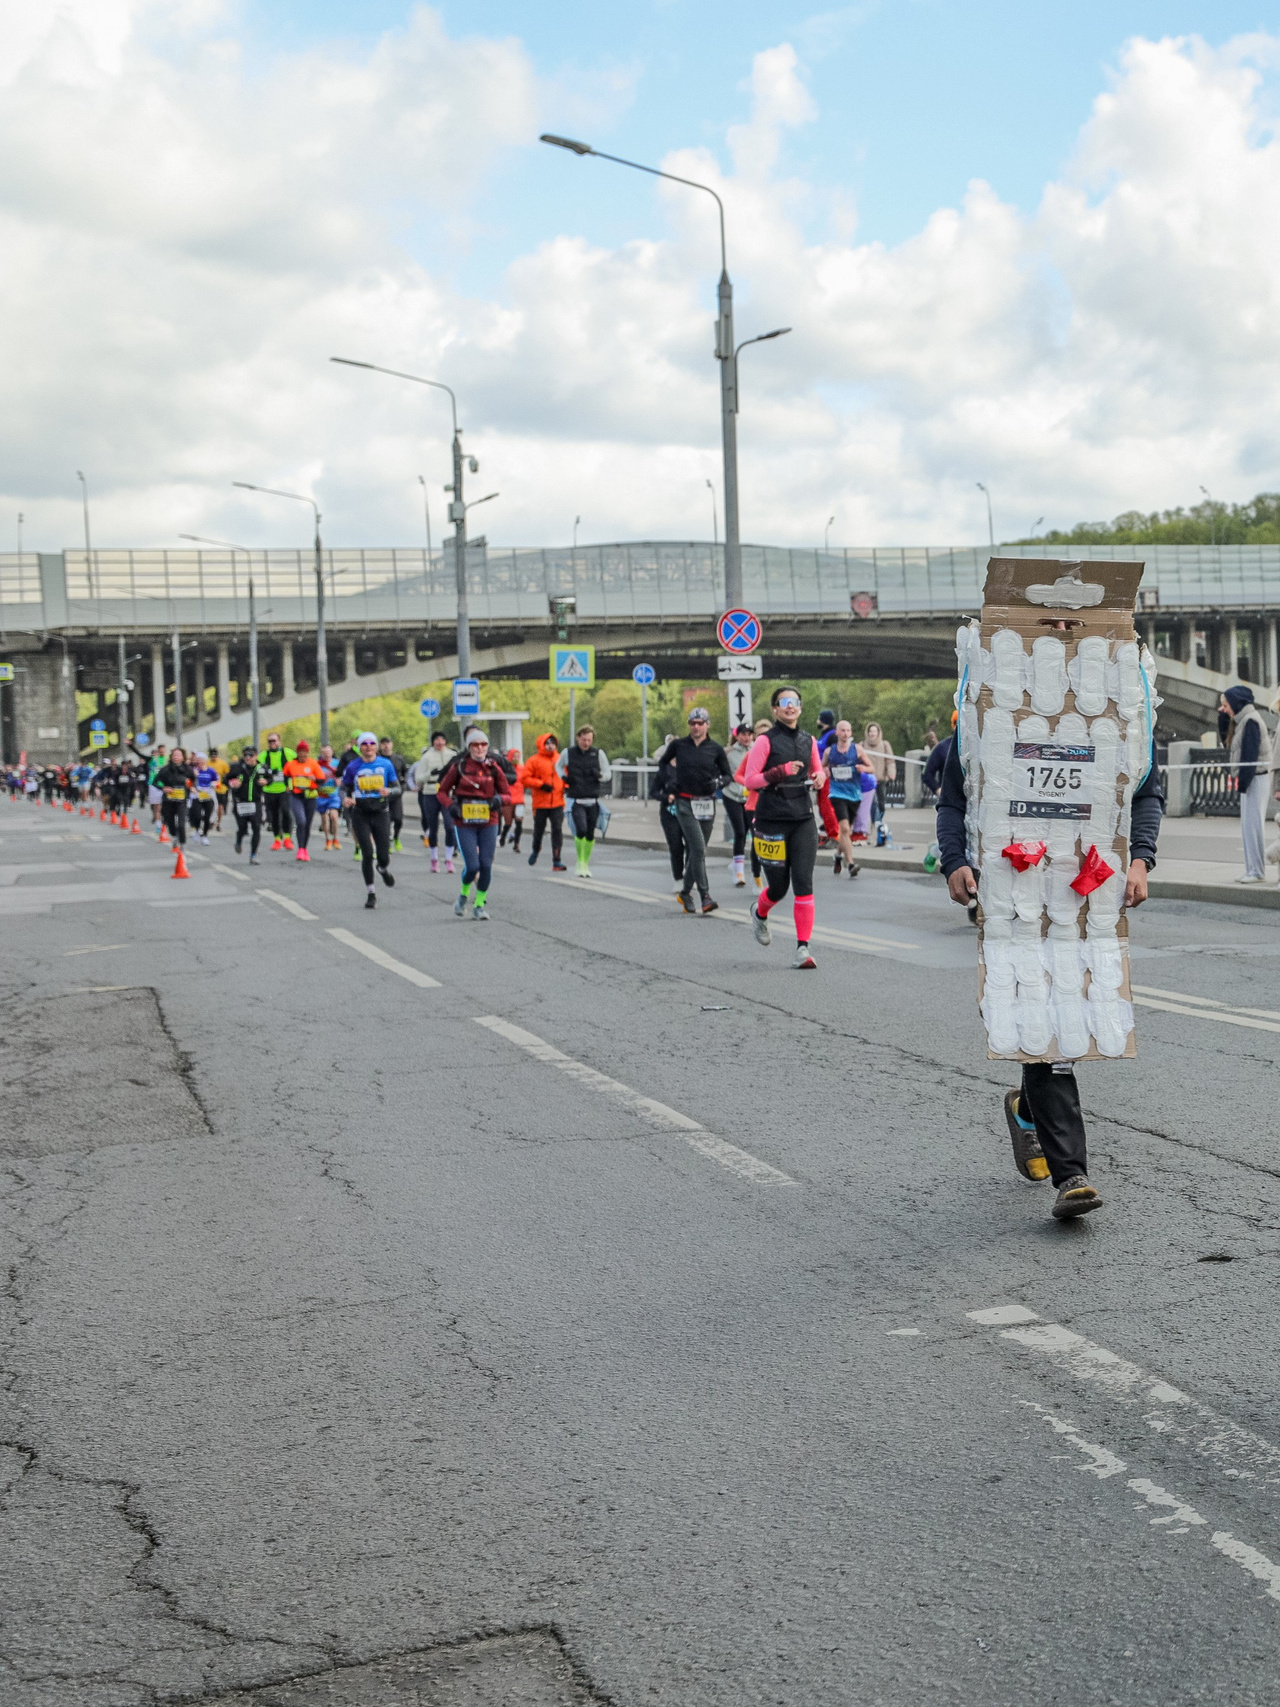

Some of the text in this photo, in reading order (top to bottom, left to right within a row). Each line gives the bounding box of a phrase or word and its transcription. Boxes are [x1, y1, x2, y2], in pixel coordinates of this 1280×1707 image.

[1026, 766, 1082, 790] 1765
[1017, 802, 1027, 814] D
[758, 842, 780, 854] 1707
